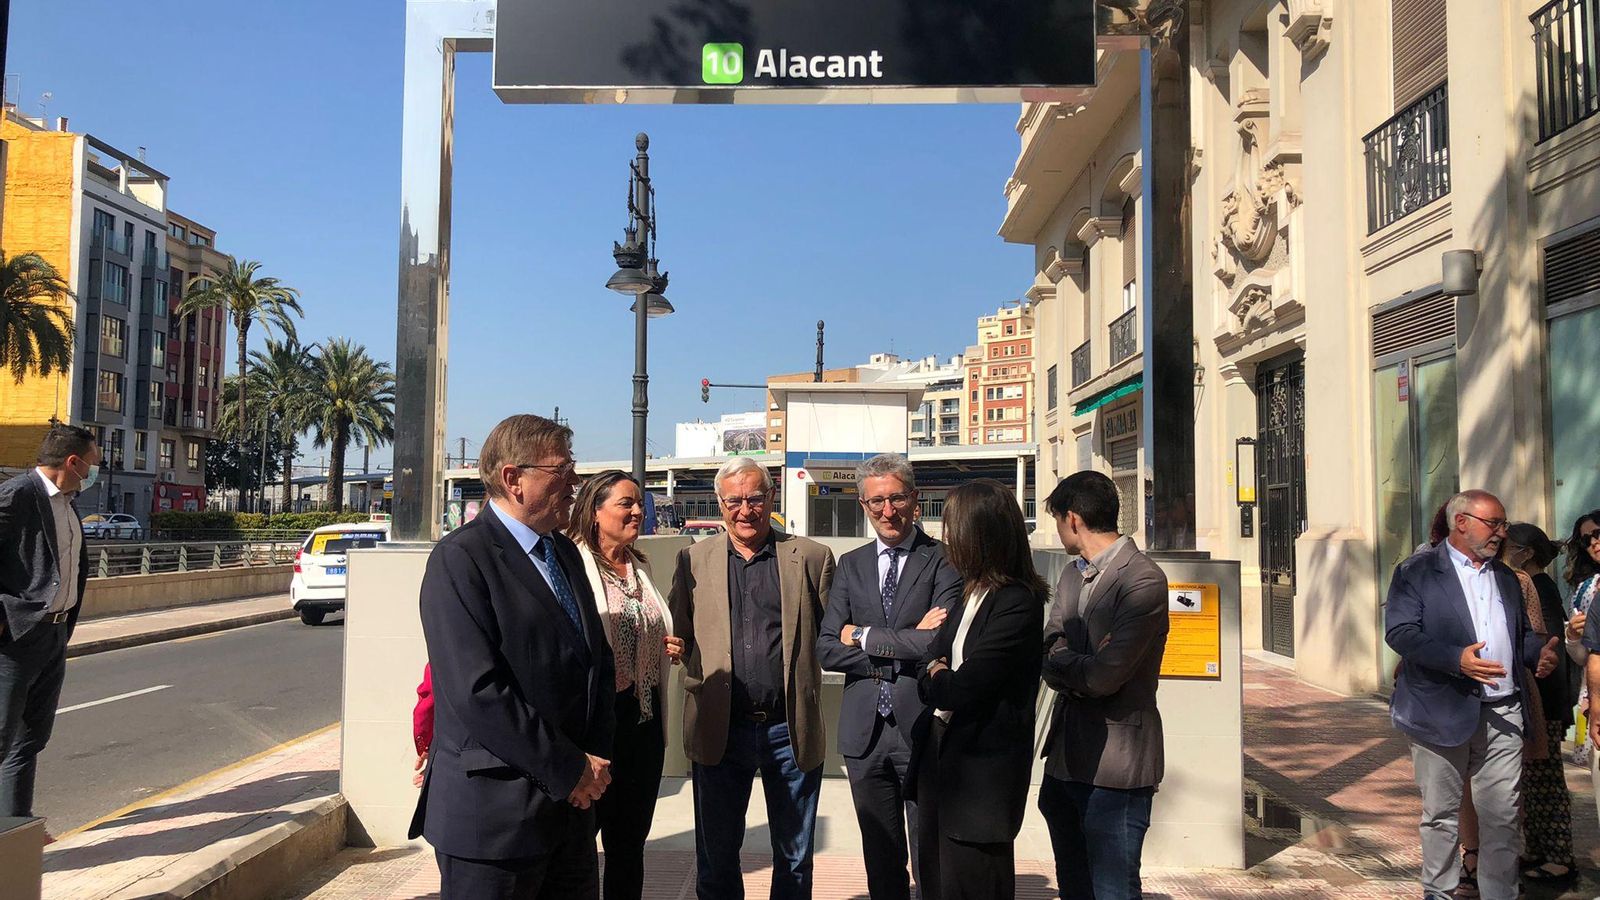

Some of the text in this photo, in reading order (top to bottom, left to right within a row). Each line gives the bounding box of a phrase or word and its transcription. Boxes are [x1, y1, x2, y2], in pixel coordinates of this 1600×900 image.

[706, 48, 884, 78] 10 Alacant
[833, 471, 856, 480] Alaca
